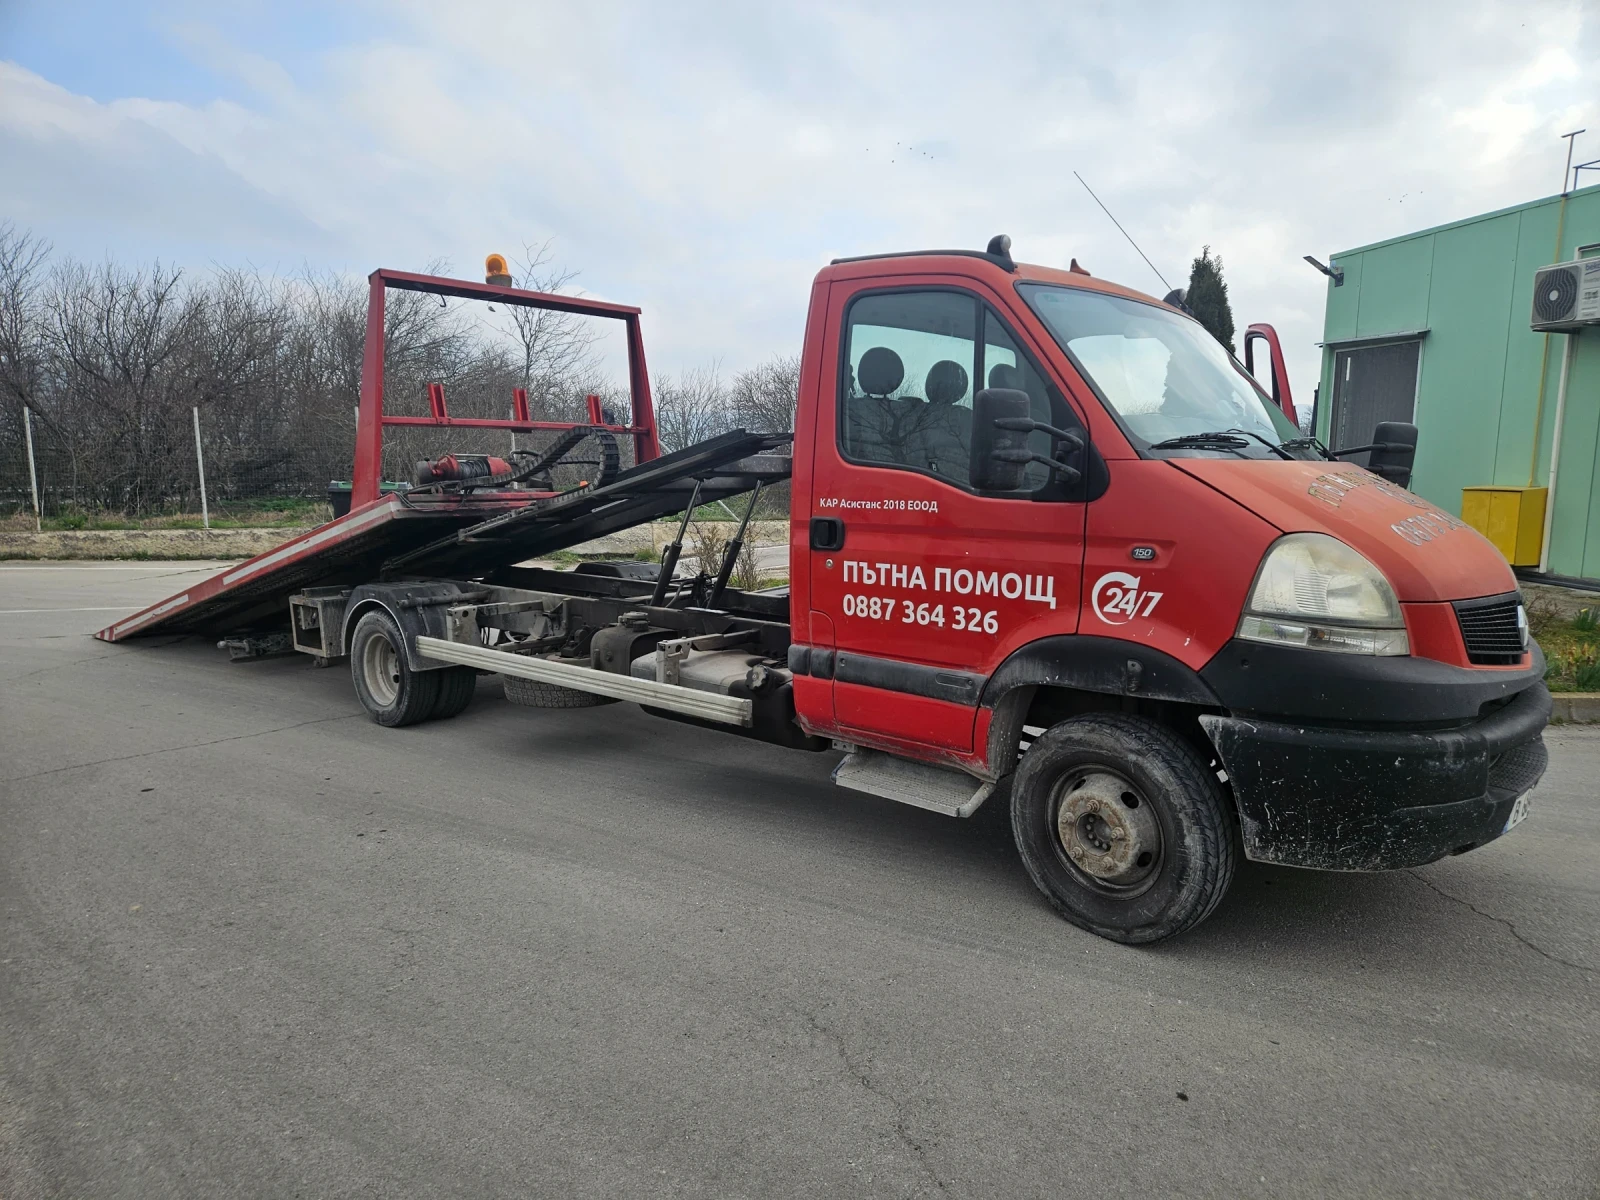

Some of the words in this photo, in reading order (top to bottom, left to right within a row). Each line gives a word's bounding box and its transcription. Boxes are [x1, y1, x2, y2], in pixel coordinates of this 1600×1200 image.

[819, 498, 838, 508] КАР
[839, 498, 882, 510] Асистанс
[883, 499, 906, 511] 2018
[907, 500, 938, 513] ЕООД
[1134, 548, 1152, 556] 150
[843, 560, 927, 590] ПЪТНА
[934, 567, 1056, 610] ПОМОЩ
[842, 593, 896, 621] 0887
[901, 600, 945, 627] 364
[951, 606, 999, 634] 326
[1103, 587, 1164, 620] 24/7
